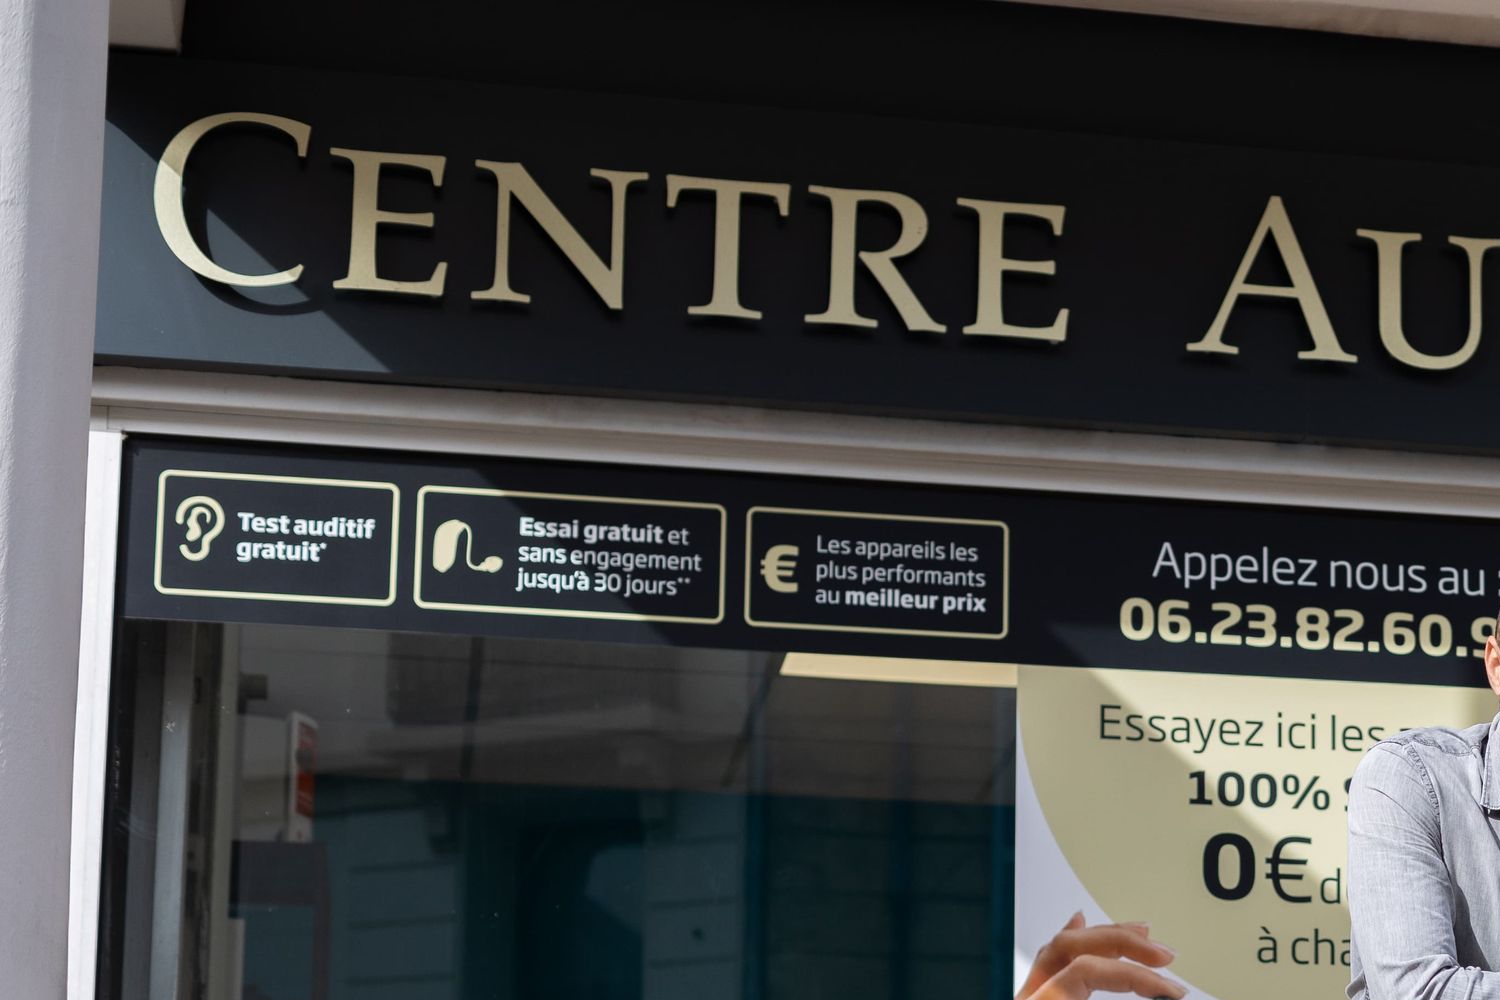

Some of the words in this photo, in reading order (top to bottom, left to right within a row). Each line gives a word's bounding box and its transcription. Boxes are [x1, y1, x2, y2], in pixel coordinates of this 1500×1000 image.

[154, 111, 1070, 345] CENTRE
[237, 511, 290, 535] Test
[293, 515, 376, 539] auditif
[519, 516, 579, 538] Essai
[583, 524, 664, 544] gratuit
[667, 527, 690, 546] et
[518, 545, 567, 564] sans
[570, 549, 702, 572] engagement
[816, 535, 851, 555] Les
[855, 538, 946, 562] appareils
[950, 541, 979, 563] les
[594, 571, 622, 592] 30
[816, 561, 858, 583] plus
[862, 565, 986, 589] performants
[1152, 541, 1318, 590] Appelez
[1329, 560, 1428, 594] nous
[1438, 566, 1486, 597] au
[815, 588, 841, 605] au
[845, 586, 938, 611] meilleur
[942, 592, 986, 615] prix
[1100, 703, 1264, 754] Essayez
[1276, 711, 1317, 750] ici
[1188, 770, 1331, 811] 100%
[1257, 926, 1278, 964] à
